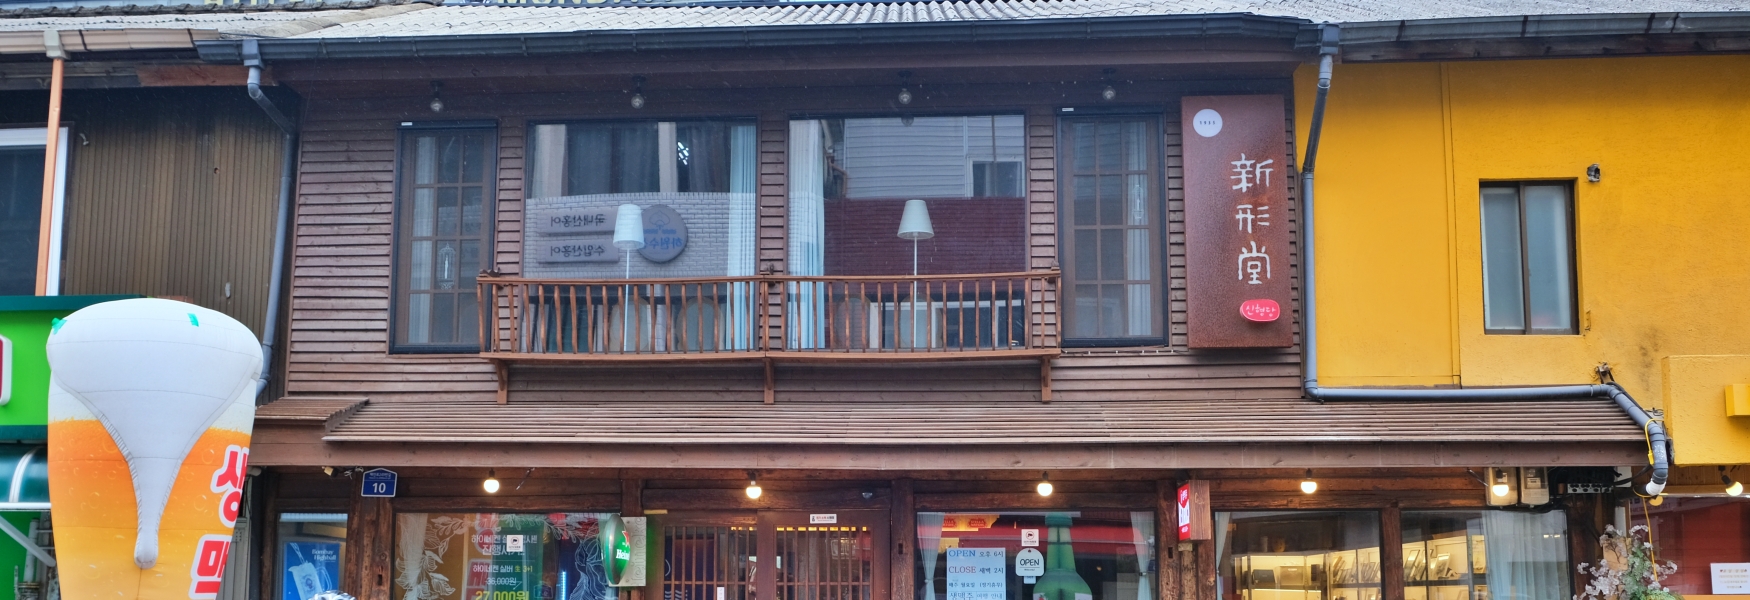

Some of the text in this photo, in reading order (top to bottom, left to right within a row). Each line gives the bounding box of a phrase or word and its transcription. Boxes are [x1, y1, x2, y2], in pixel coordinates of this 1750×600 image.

[1229, 152, 1274, 285] 新形堂
[1245, 303, 1277, 318] 신형당
[372, 482, 387, 494] 10
[948, 550, 976, 558] OPEN
[1019, 558, 1040, 567] OPEN
[472, 564, 499, 573] 하이네켄
[948, 565, 977, 574] CLOSE
